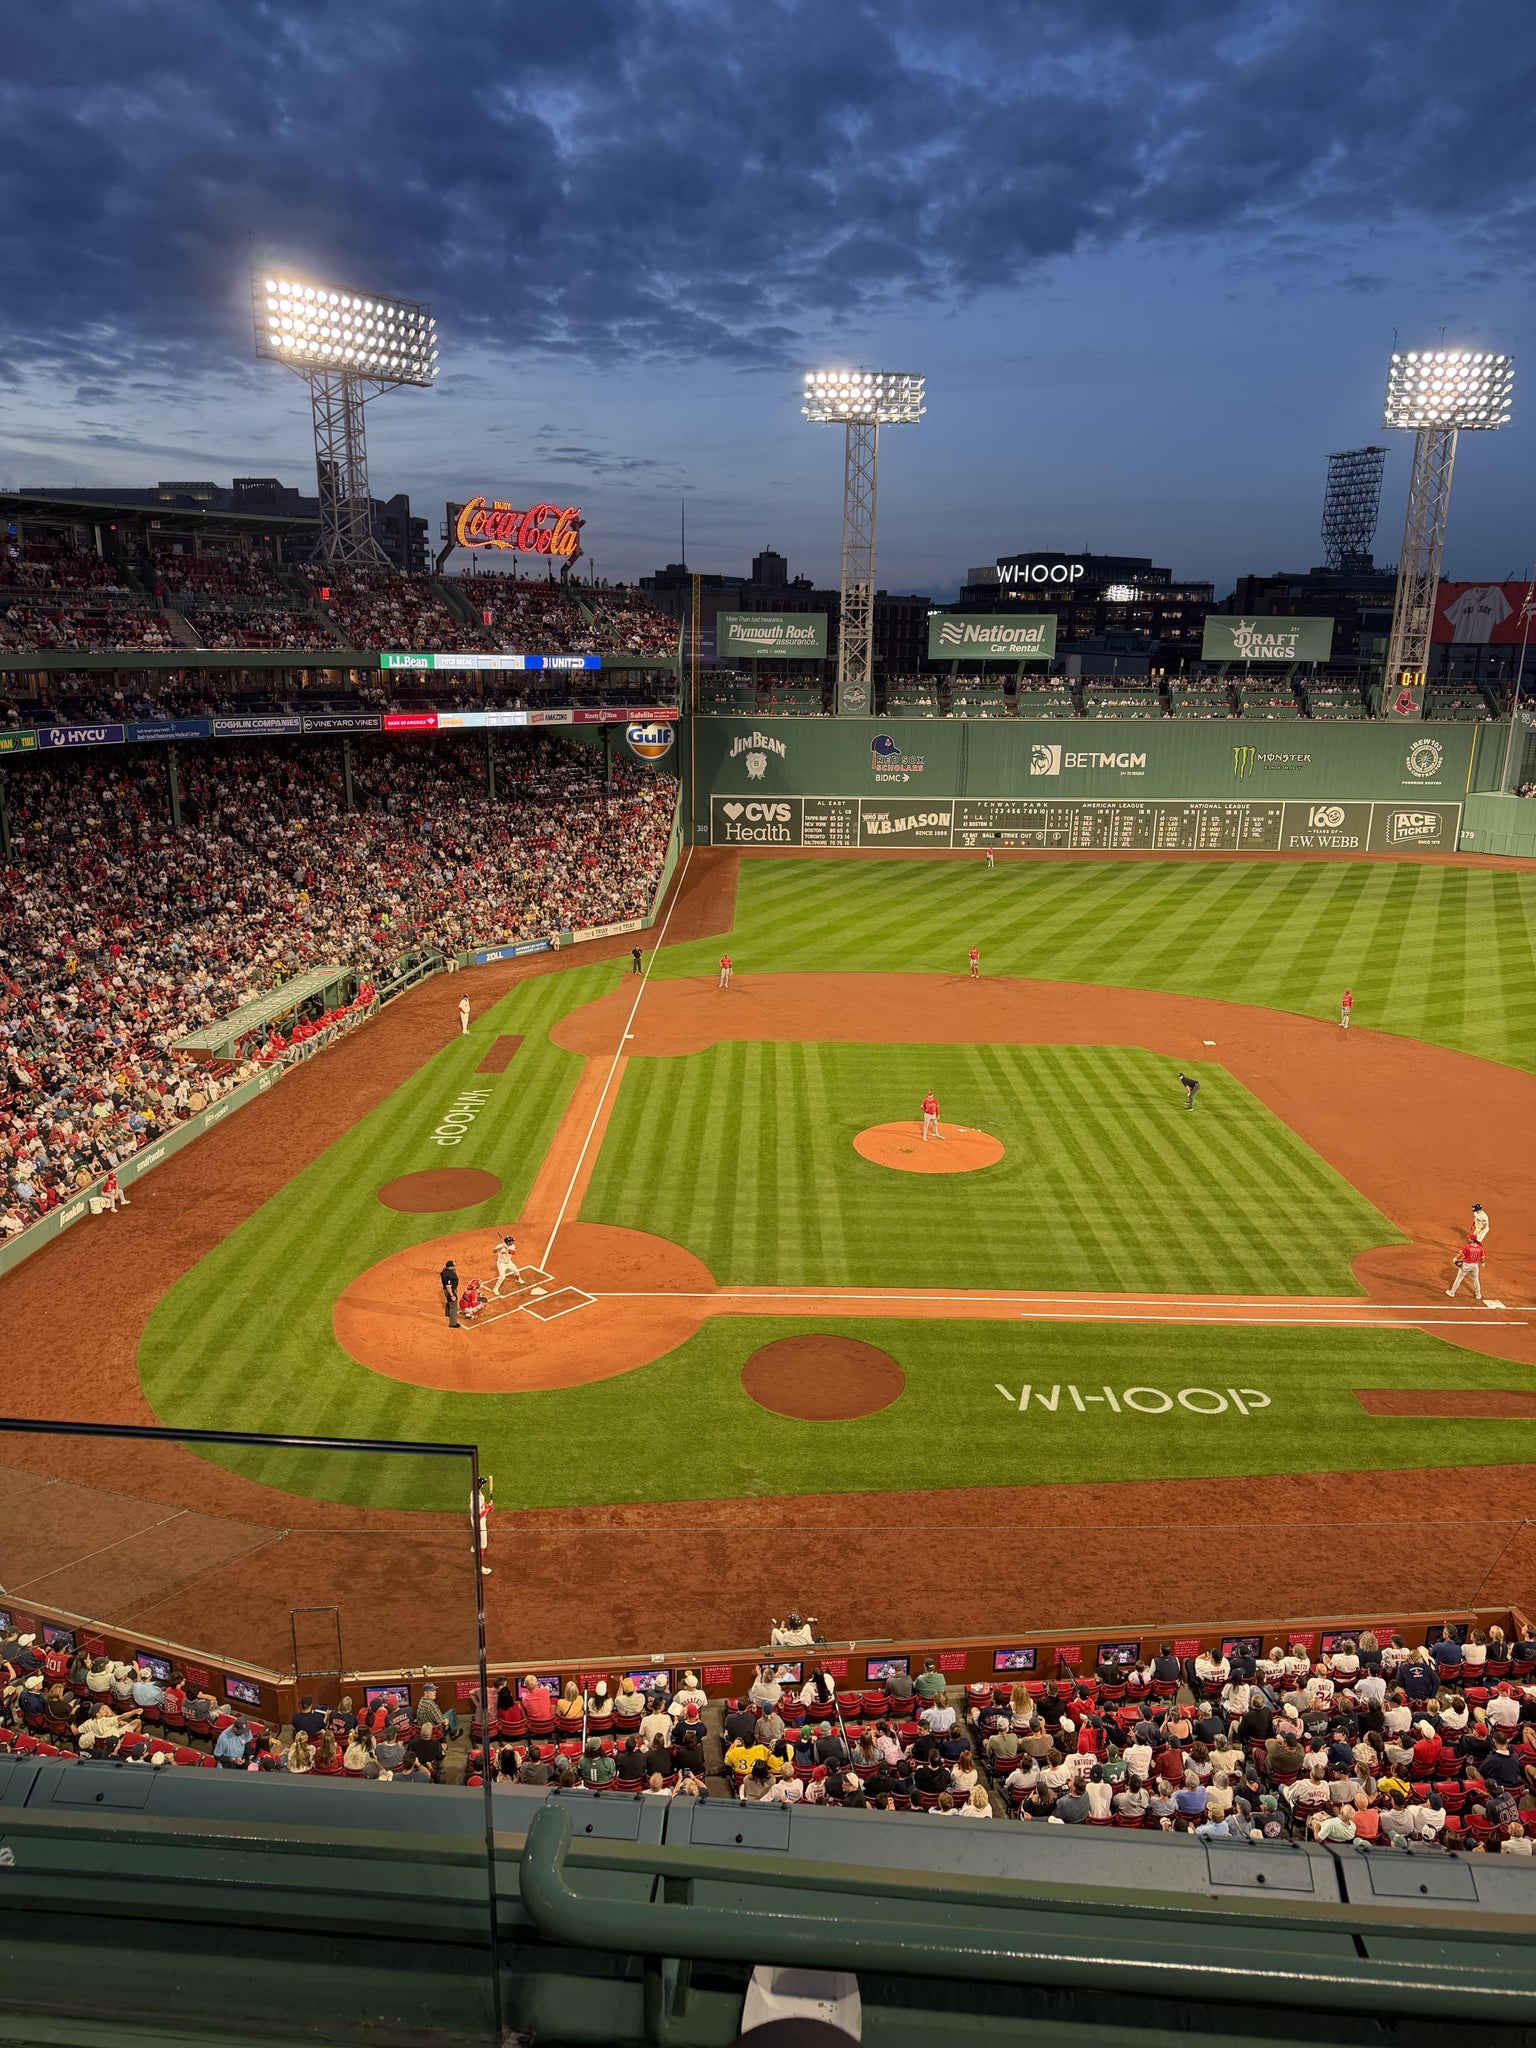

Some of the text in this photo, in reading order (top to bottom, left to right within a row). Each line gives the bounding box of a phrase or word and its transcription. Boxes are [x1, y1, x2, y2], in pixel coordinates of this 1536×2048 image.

[456, 496, 581, 556] Coca-Cola
[996, 564, 1084, 583] WHOOP
[729, 624, 816, 639] Plymouth Rock
[963, 624, 1045, 642] National
[1234, 632, 1299, 648] DRAFT
[991, 644, 1040, 652] Car Rental
[1240, 645, 1295, 658] KINGS
[552, 658, 585, 668] UNITED
[1401, 673, 1425, 686] 0:11
[215, 719, 299, 729] COGHLIN COMPANIES
[312, 719, 354, 728] VINEYARD
[21, 737, 34, 747] TIRE
[68, 730, 105, 743] HYCU
[628, 728, 671, 744] Gulf
[729, 731, 787, 759] JIM BEAM
[1410, 739, 1431, 751] IBEW
[876, 756, 925, 765] RED SOX
[1064, 753, 1147, 768] BETMGM
[875, 764, 924, 772] SCHOLARS
[875, 774, 901, 782] BIDMC
[745, 803, 791, 822] CVS
[1308, 806, 1345, 827] 160
[1398, 813, 1437, 828] ACE
[725, 823, 791, 841] Health
[1398, 826, 1436, 837] TICKET
[1460, 831, 1475, 839] 379
[964, 838, 975, 846] 32
[1289, 836, 1359, 848] F.W. WEBB
[486, 952, 503, 961] ZOLL
[430, 1088, 493, 1146] WHOOP
[60, 1201, 85, 1228] Franklin
[994, 1383, 1272, 1415] WHOOP
[590, 1768, 597, 1781] 11
